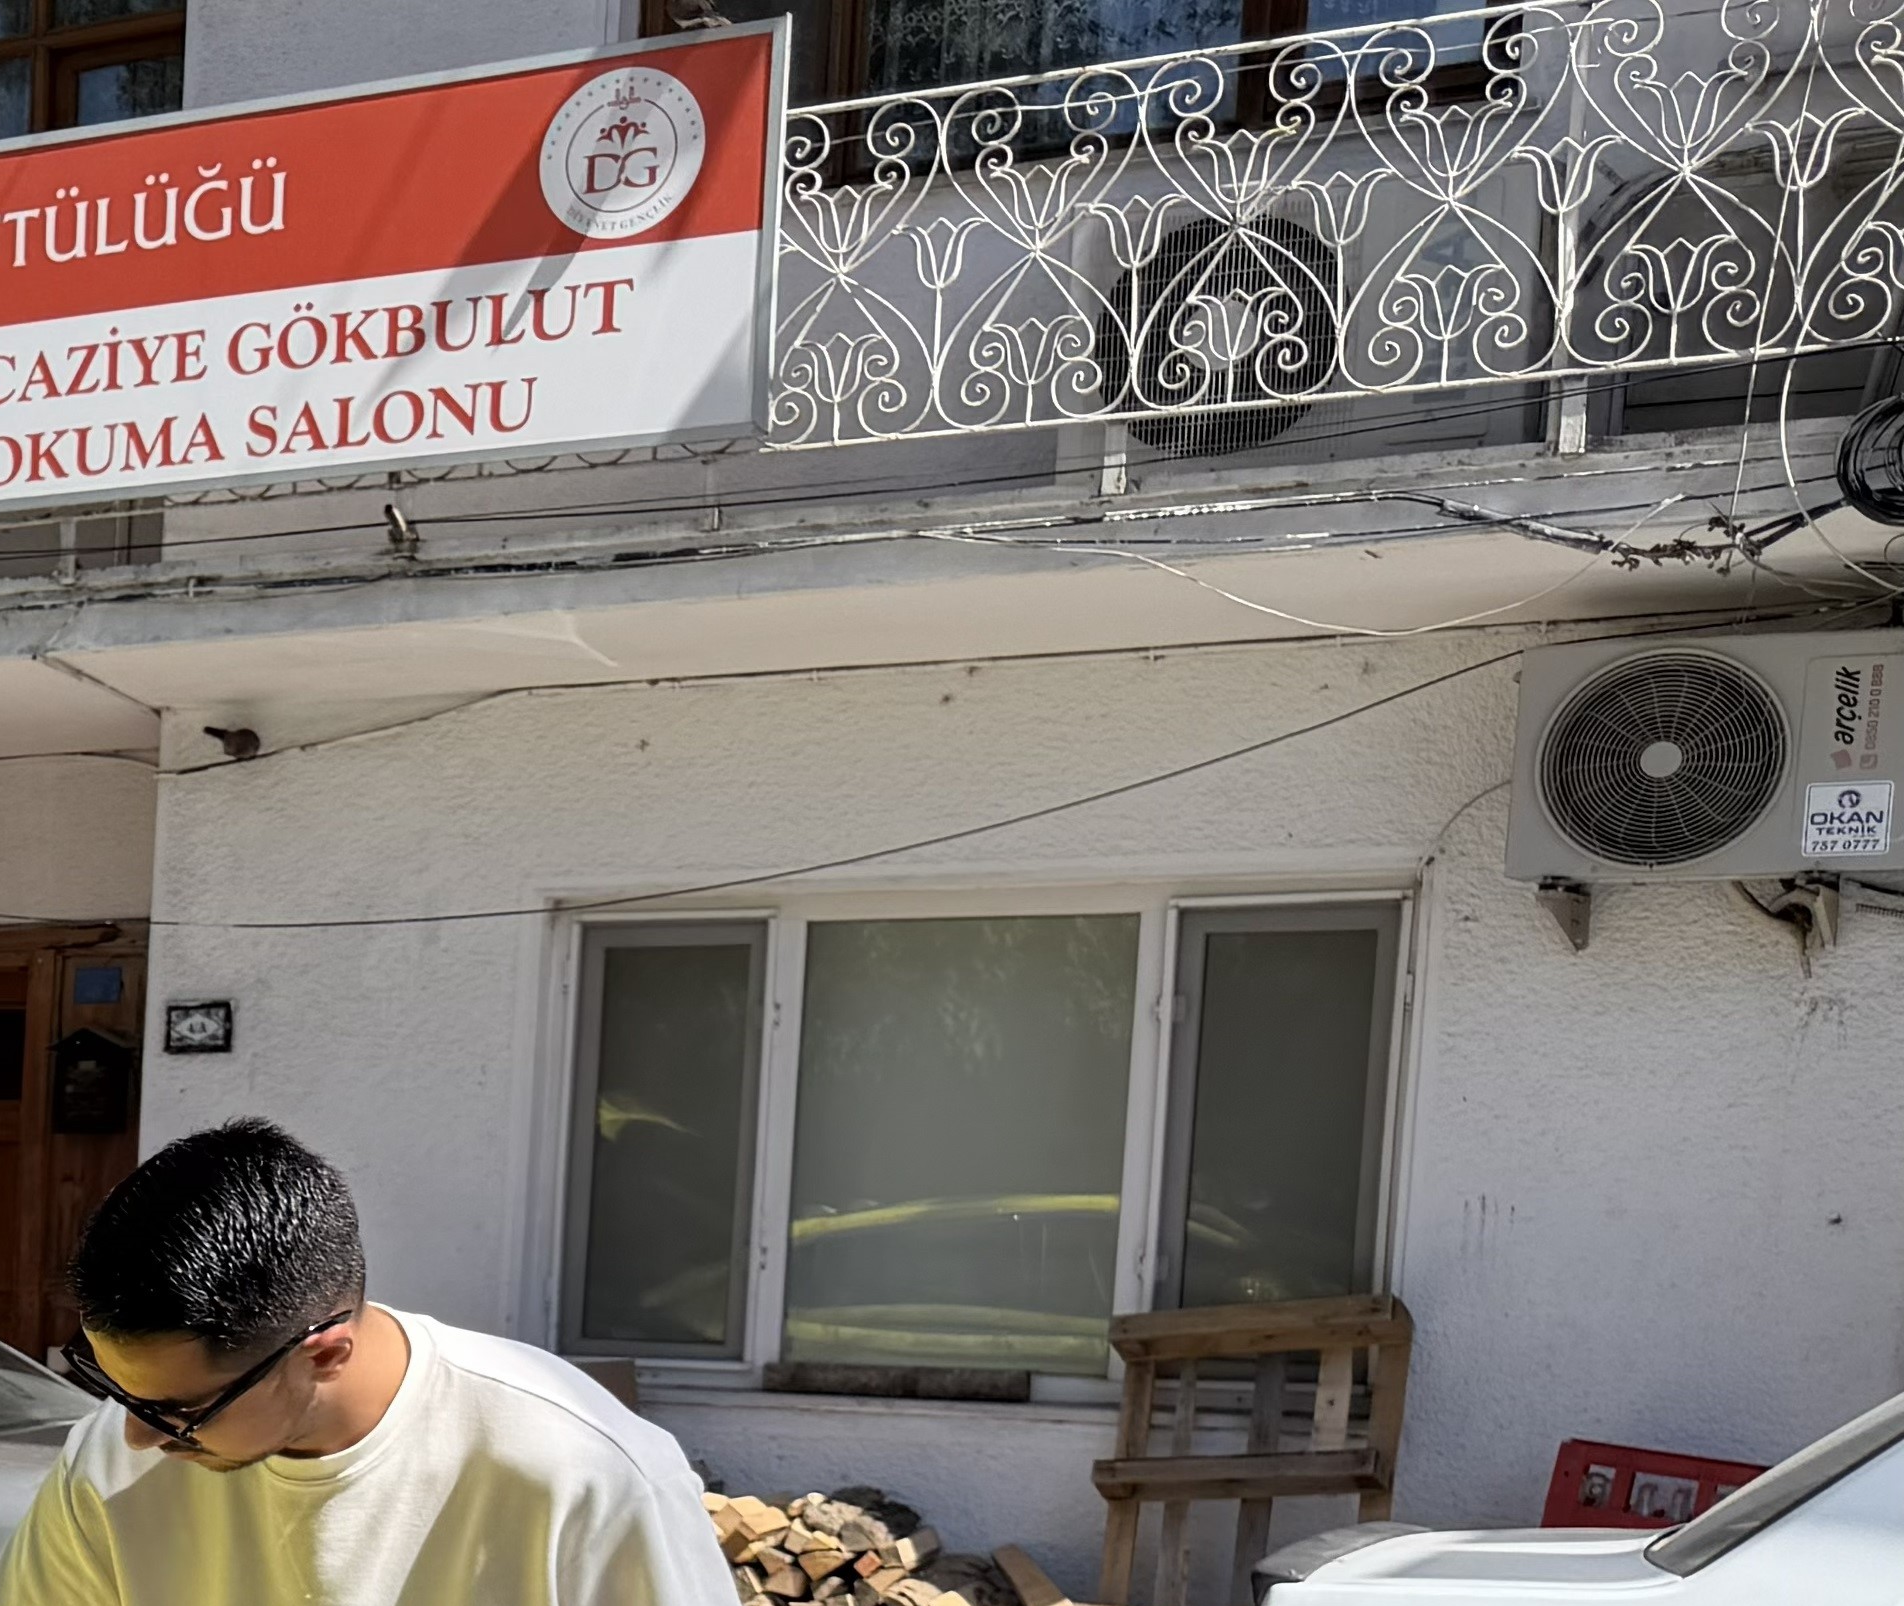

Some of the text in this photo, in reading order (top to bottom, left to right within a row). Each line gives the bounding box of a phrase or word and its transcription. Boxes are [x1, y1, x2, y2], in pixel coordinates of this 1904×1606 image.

[226, 278, 637, 377] GÖKBULUT
[246, 376, 535, 460] SALONU
[1834, 666, 1862, 745] arçelik
[1810, 811, 1884, 825] OKAN
[1812, 838, 1880, 851] 757 0777
